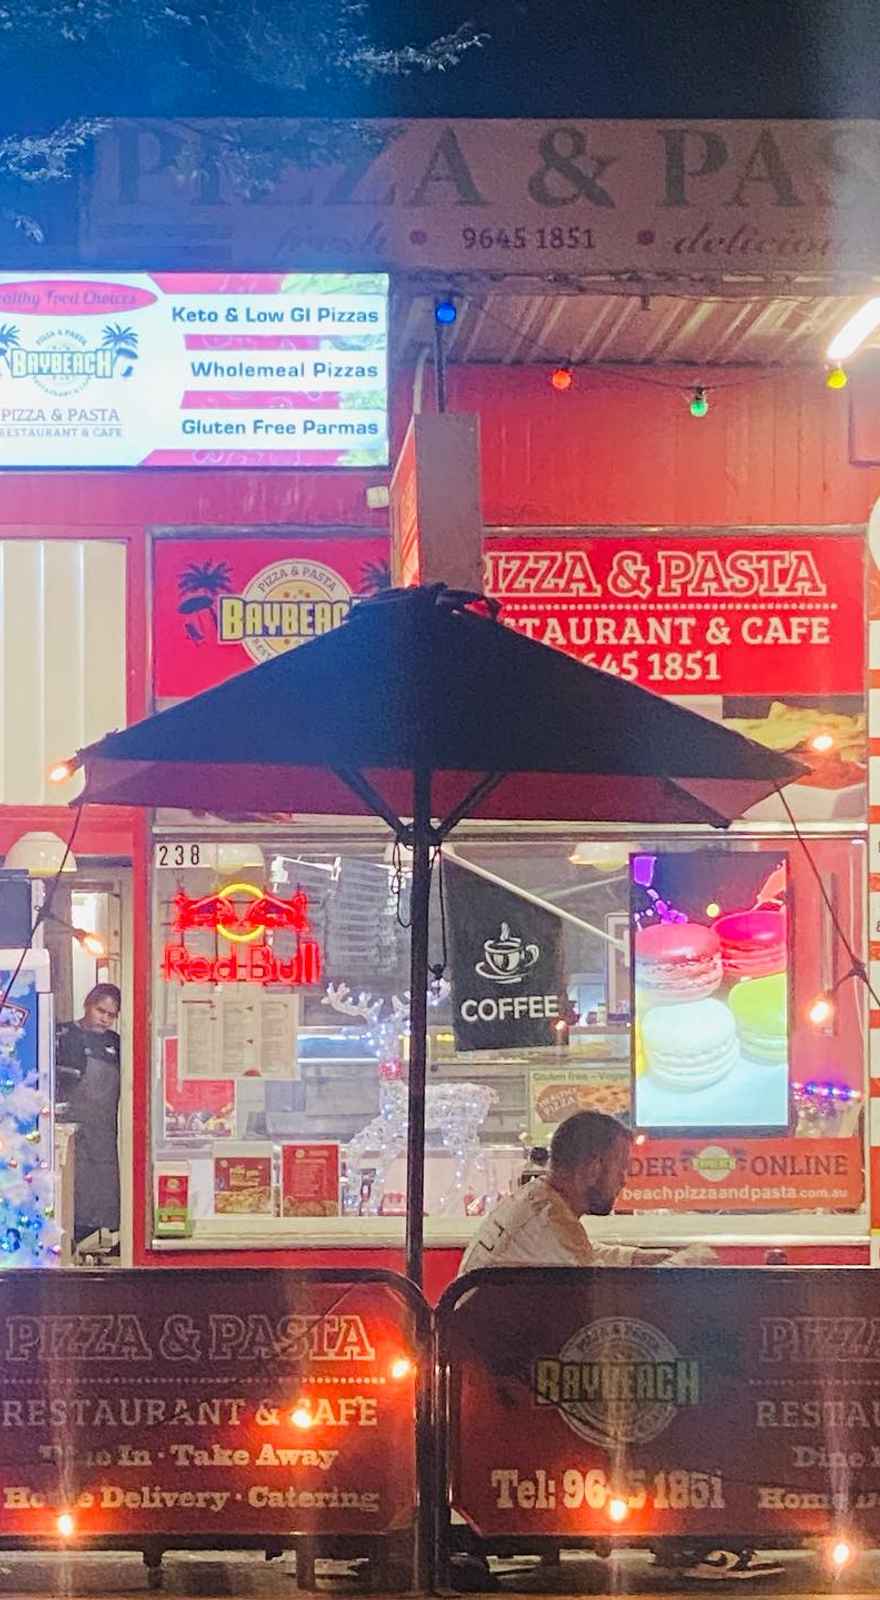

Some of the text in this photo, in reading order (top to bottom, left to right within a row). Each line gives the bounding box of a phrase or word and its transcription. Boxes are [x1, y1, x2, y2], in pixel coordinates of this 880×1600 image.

[527, 125, 617, 209] &
[461, 226, 527, 250] 9645
[535, 226, 596, 250] 1851
[172, 306, 379, 323] Keto & Low GI Pizzas
[11, 348, 113, 378] BAYBEACH
[190, 361, 379, 379] Wholemeal Pizzas
[1, 407, 121, 422] PIZZA & PASTA
[181, 418, 379, 435] Gluten Free Parmas
[93, 427, 122, 438] CAFE
[257, 566, 337, 592] PIZZA & PASTA
[482, 550, 828, 599] IZZA & PASTA
[220, 596, 362, 642] BAYBEAC
[705, 617, 732, 646] &
[740, 617, 832, 646] CAFE
[647, 651, 722, 682] 1851
[158, 845, 201, 866] 238
[163, 940, 321, 984] Red Bull
[460, 994, 560, 1023] COFFEE
[751, 1154, 850, 1177] ONLINE
[5, 1314, 376, 1362] PIZZA & PASTA
[2, 1399, 246, 1427] RESTAURANT
[255, 1400, 280, 1426] &
[117, 1444, 152, 1467] In
[169, 1444, 249, 1467] Take
[255, 1444, 340, 1470] Away
[3, 1486, 380, 1512] Hoe Delivery Catering
[490, 1467, 728, 1511] Tel: 965 1851
[758, 1486, 849, 1510] Hom
